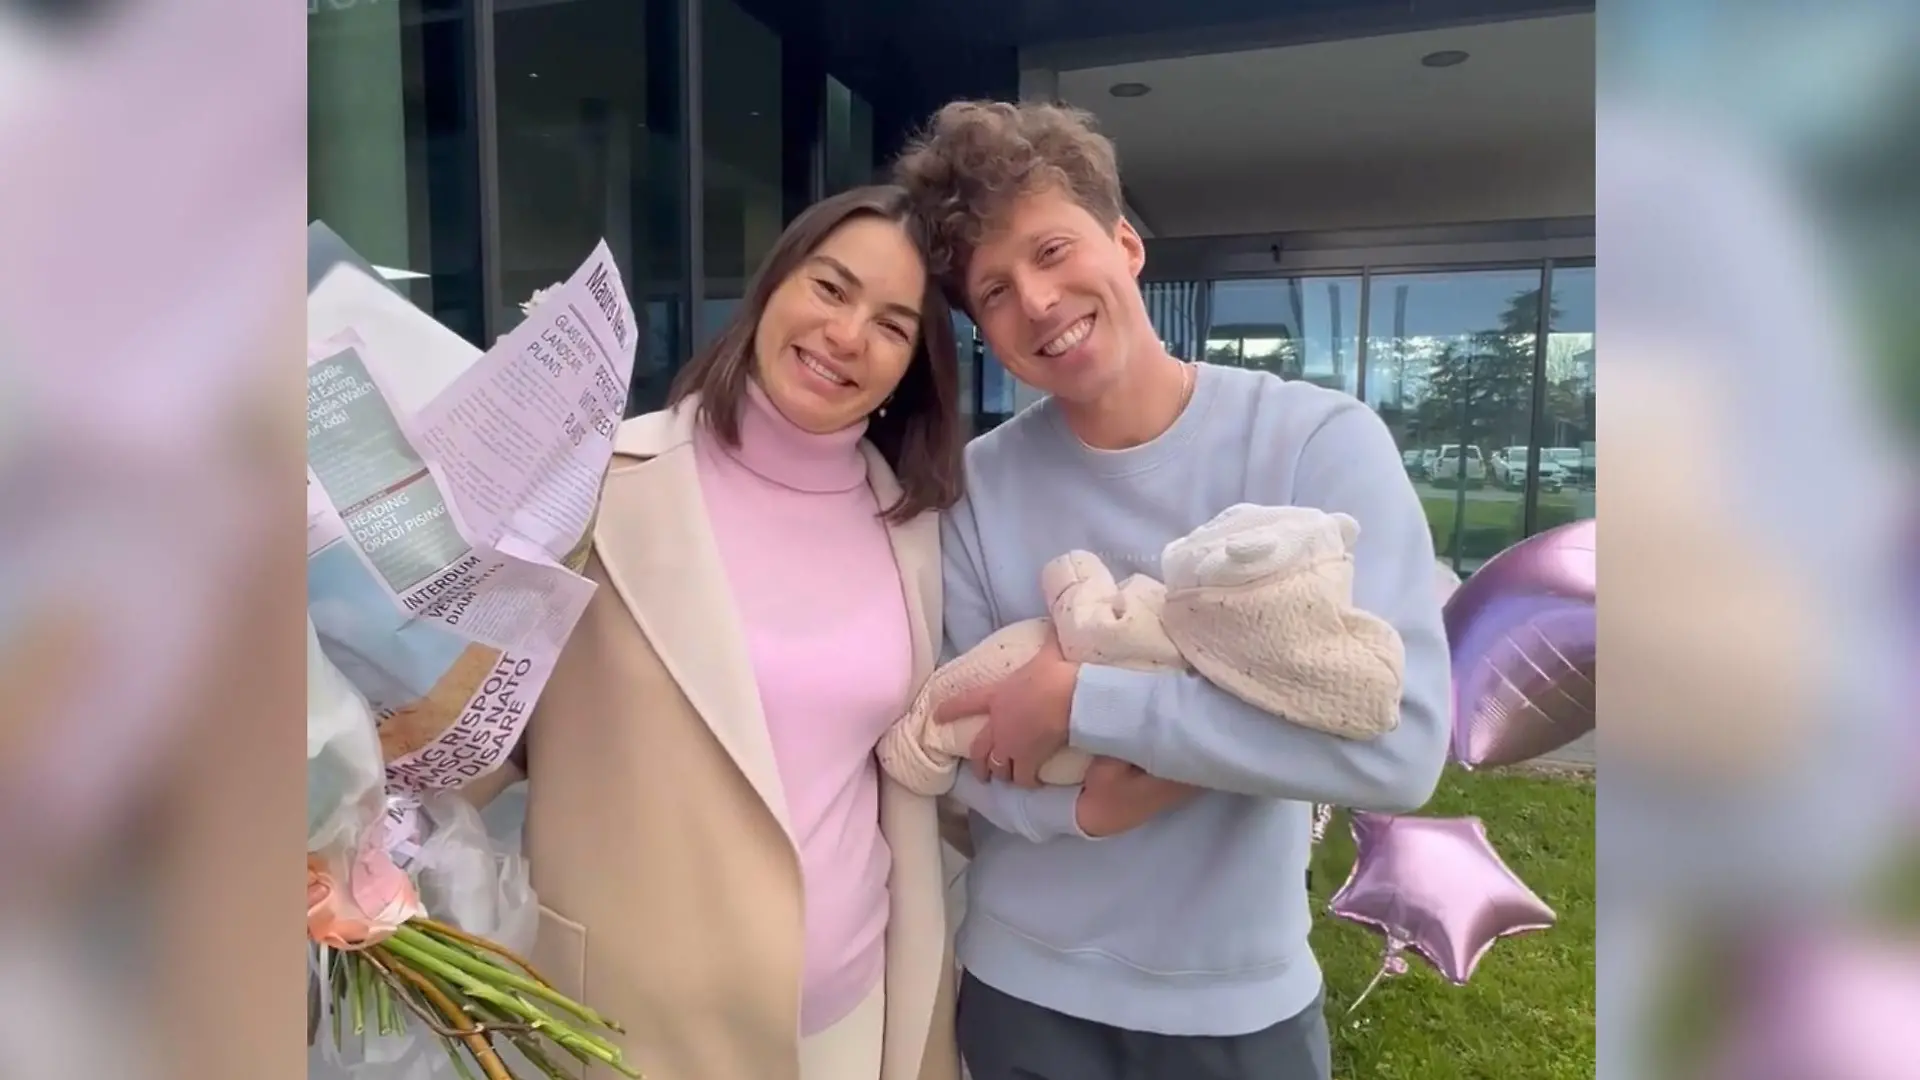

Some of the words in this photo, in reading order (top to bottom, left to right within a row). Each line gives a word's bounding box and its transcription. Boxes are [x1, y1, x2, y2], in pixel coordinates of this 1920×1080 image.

[527, 341, 563, 378] PLANTS
[317, 375, 357, 398] Eating
[337, 381, 376, 405] Watch
[347, 492, 411, 531] HEADING
[355, 512, 399, 542] DURST
[363, 525, 407, 553] ORADI
[403, 502, 446, 533] PISING
[402, 555, 482, 611] INTERDUM
[445, 590, 477, 626] DIAM
[439, 651, 516, 746] RISPOIT
[484, 658, 532, 724] NATO
[457, 701, 527, 777] DISARE
